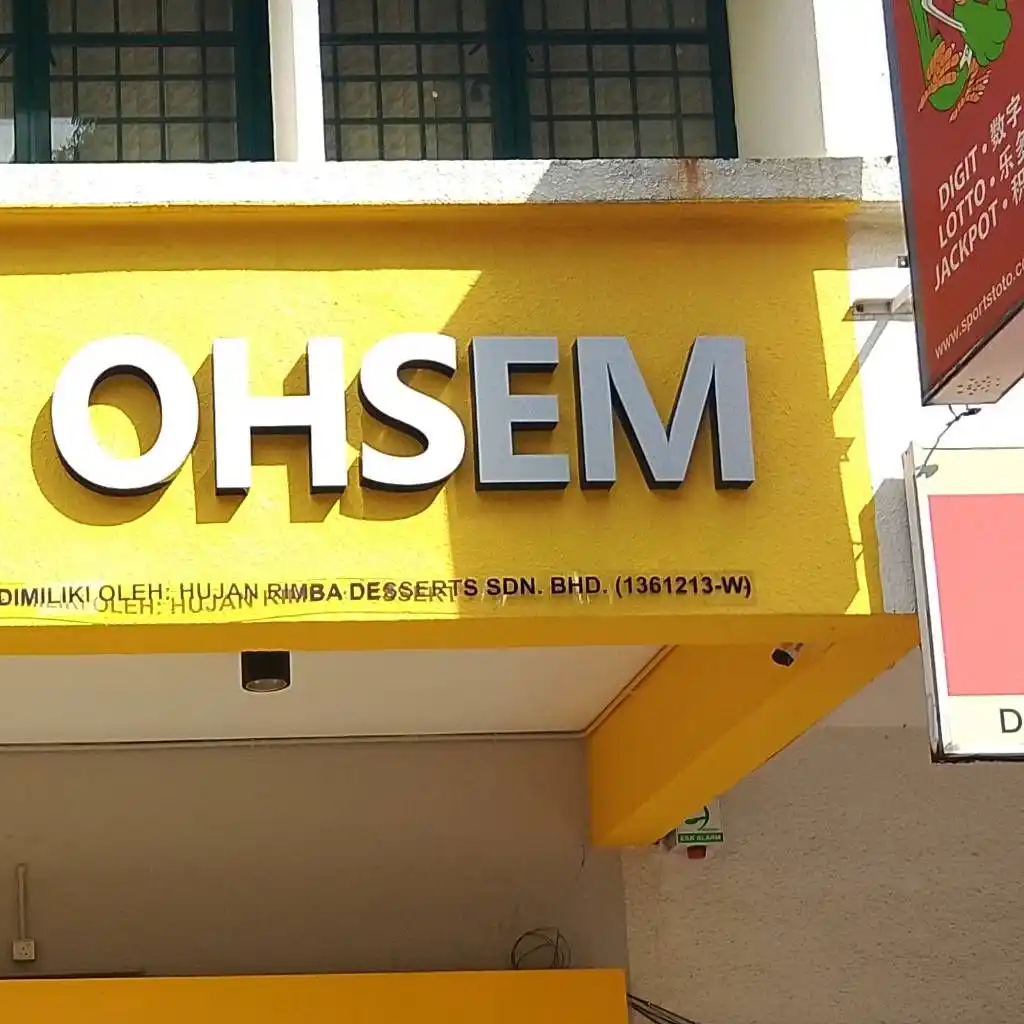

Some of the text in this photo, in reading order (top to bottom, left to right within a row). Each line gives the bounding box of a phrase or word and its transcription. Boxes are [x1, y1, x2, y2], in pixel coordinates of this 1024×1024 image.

[938, 144, 978, 211] DIGIT
[934, 198, 998, 292] JACKPOT
[938, 178, 986, 249] LOTTO
[50, 332, 756, 496] OHSEM
[179, 582, 259, 602] HUJAN
[266, 582, 343, 602] RIMBA
[350, 578, 478, 602] DESSERTS
[486, 578, 543, 596] SDN.
[550, 575, 608, 595] BHD.
[615, 574, 752, 600] (1361213-W)
